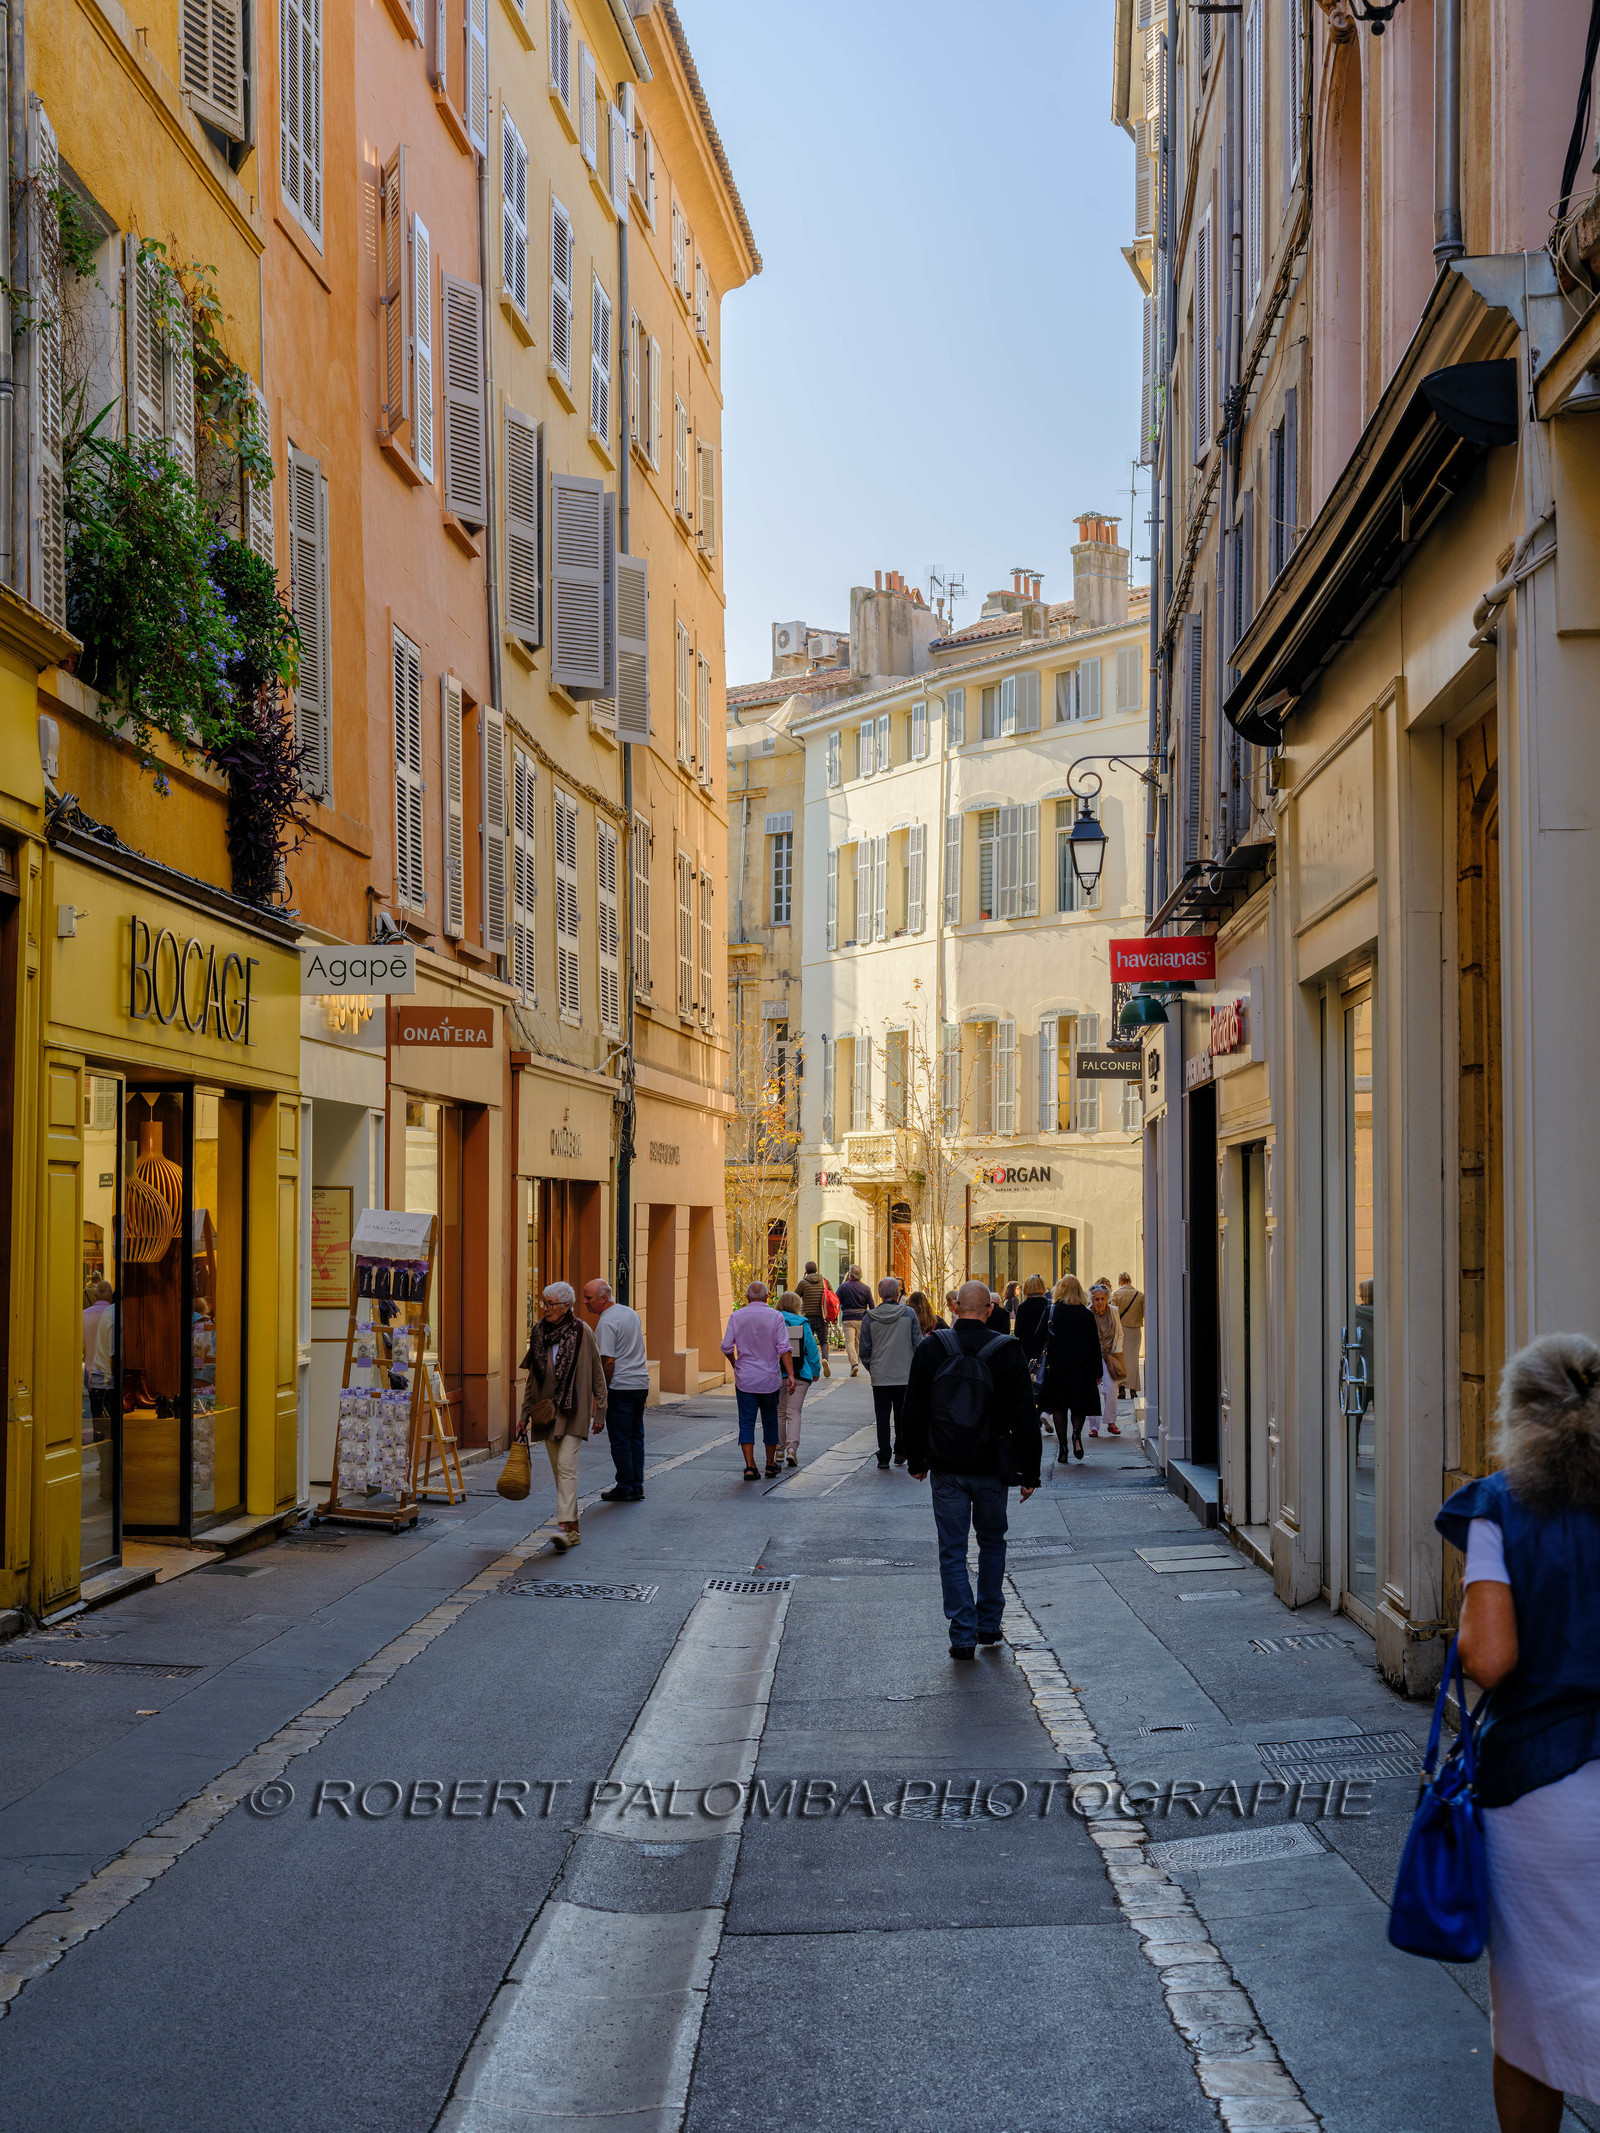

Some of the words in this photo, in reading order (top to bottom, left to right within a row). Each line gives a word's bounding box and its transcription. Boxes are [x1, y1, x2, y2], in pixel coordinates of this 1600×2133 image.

[1116, 951, 1207, 968] havaianas
[130, 915, 259, 1047] BOCAGE
[403, 1026, 488, 1042] ONATERA
[1082, 1061, 1141, 1071] FALCONERI
[983, 1166, 1051, 1184] MORGAN
